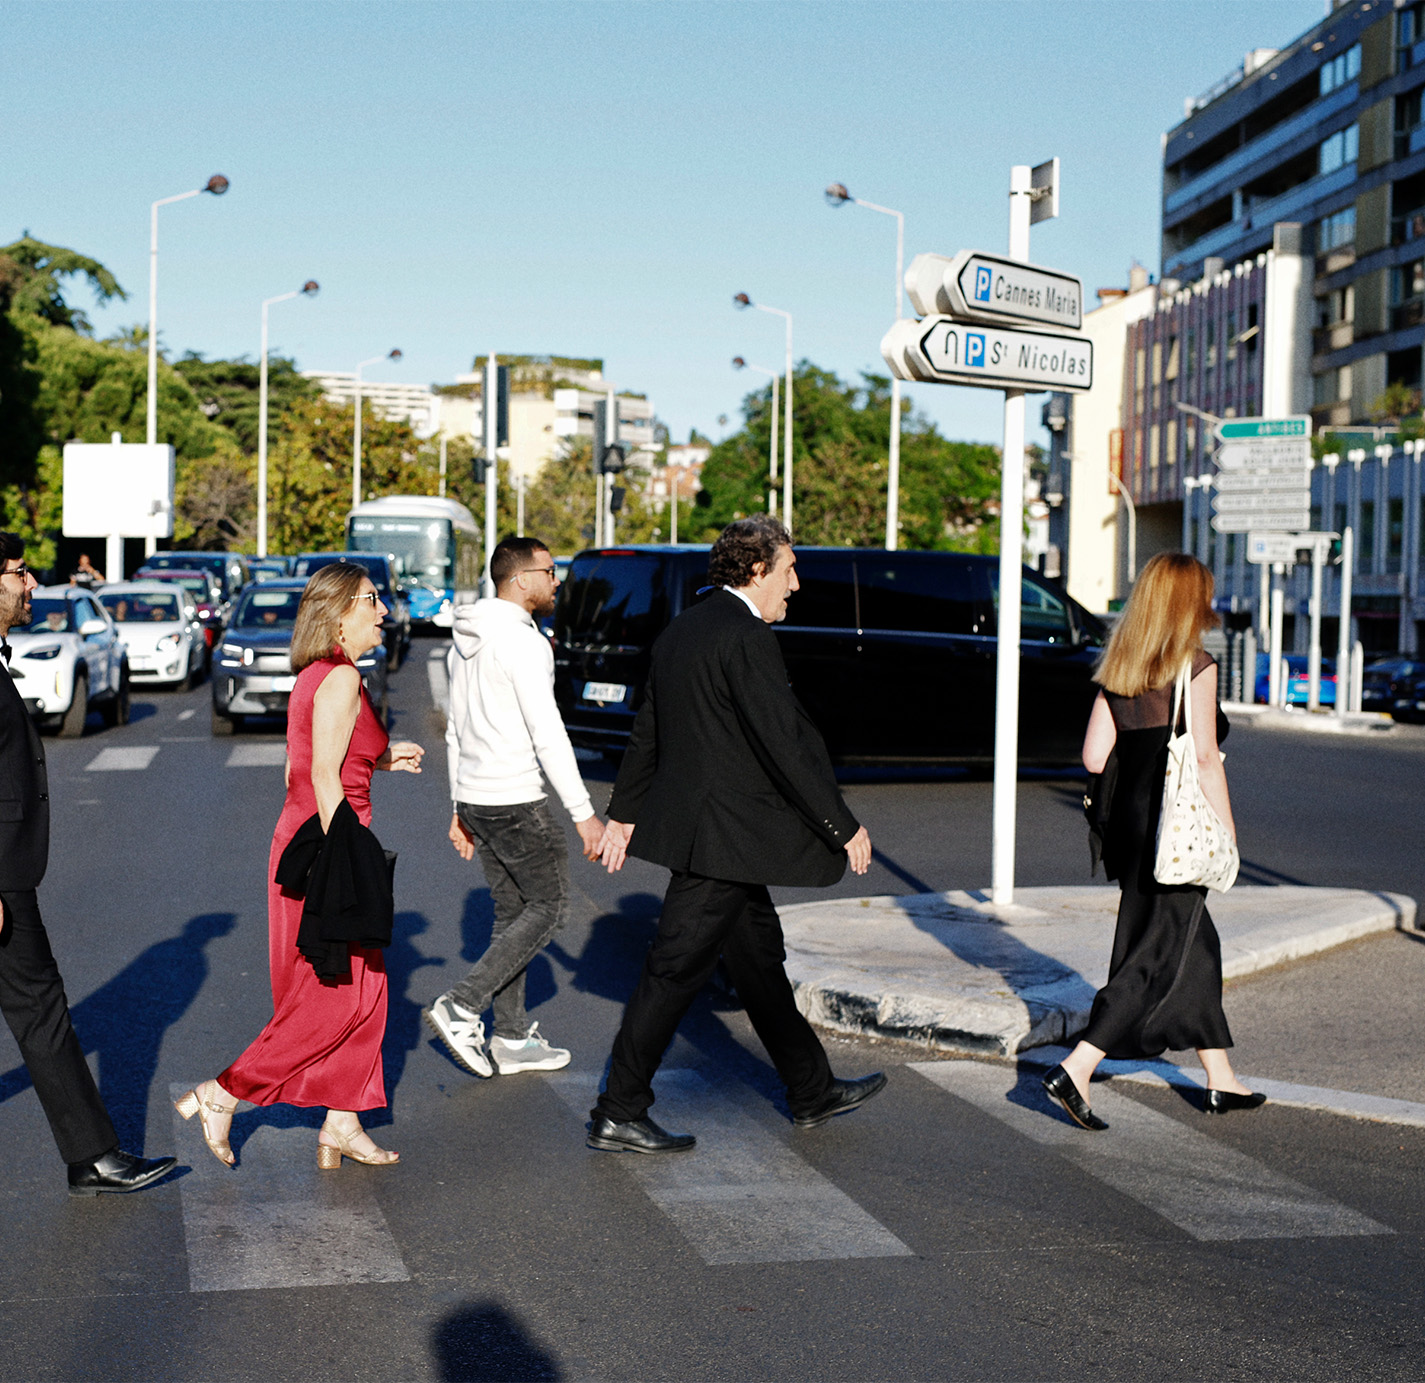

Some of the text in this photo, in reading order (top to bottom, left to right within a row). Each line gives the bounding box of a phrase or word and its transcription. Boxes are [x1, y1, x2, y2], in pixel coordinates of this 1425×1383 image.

[995, 275, 1041, 308] Cannes
[1044, 286, 1077, 316] Maria
[1018, 344, 1086, 376] Nicolas
